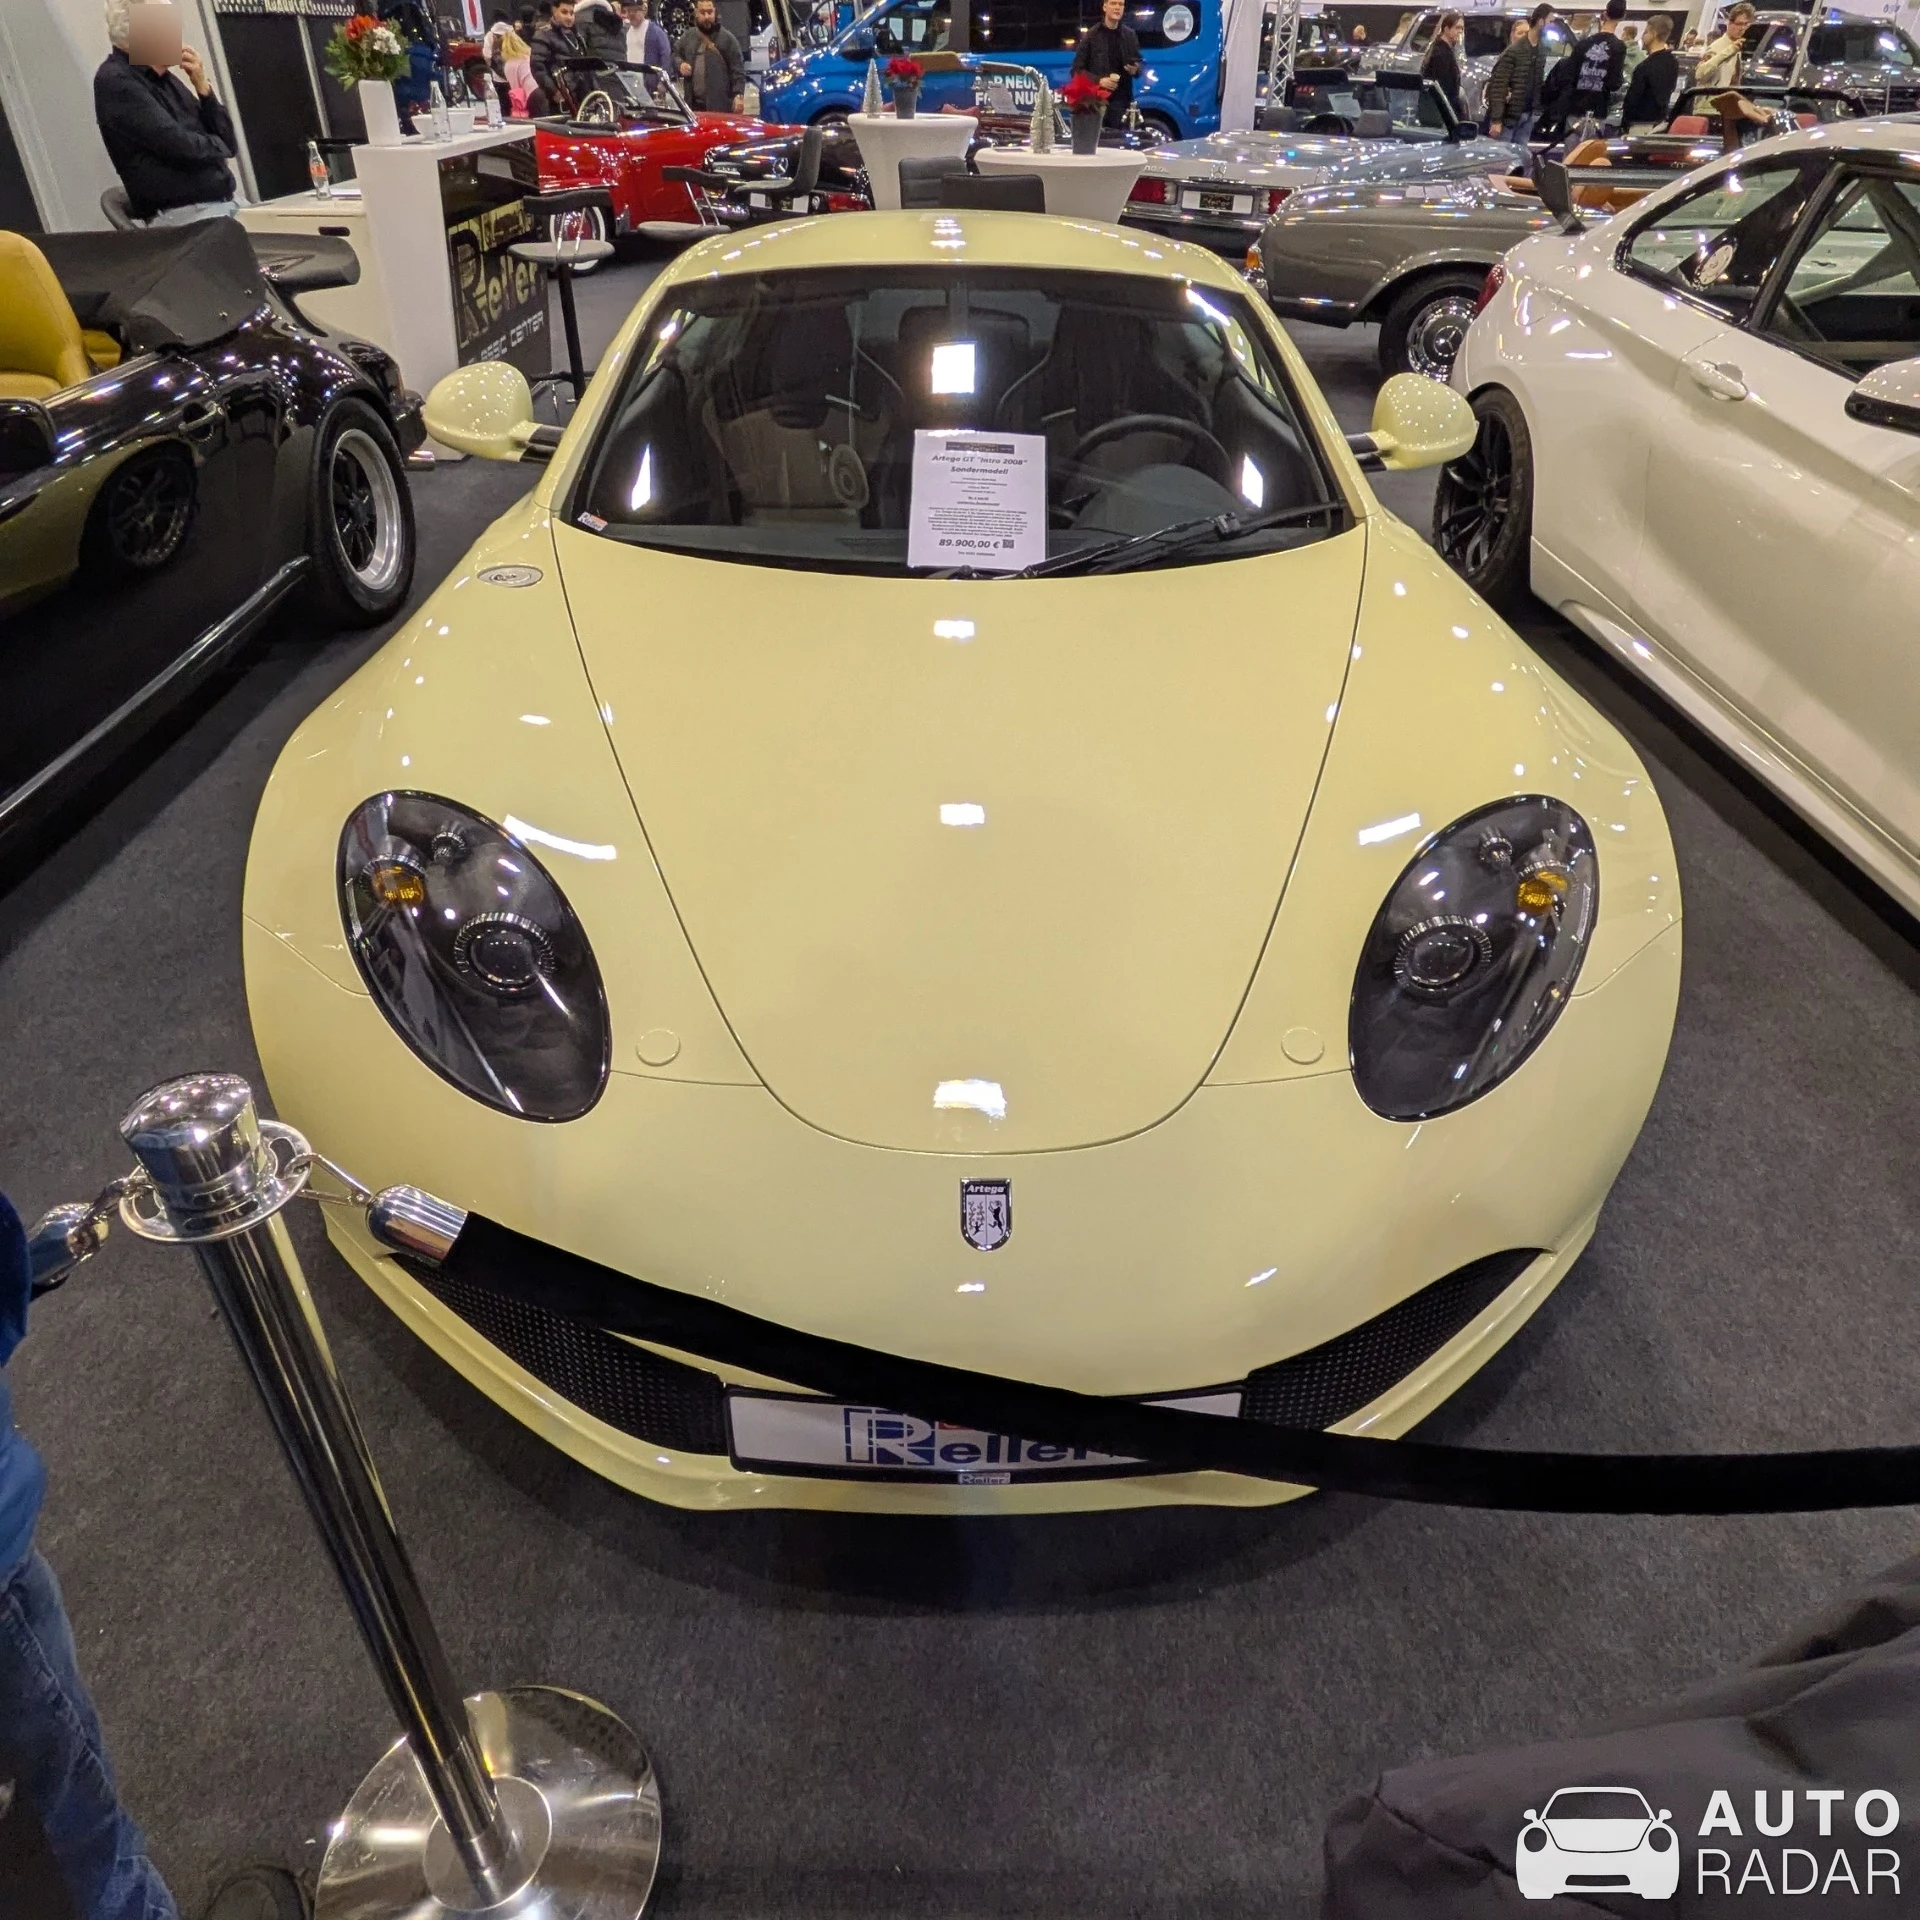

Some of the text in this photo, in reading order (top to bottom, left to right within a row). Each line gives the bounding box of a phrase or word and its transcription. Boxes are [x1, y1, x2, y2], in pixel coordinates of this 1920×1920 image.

[1015, 91, 1068, 105] NUE
[510, 310, 544, 347] CENTER
[931, 455, 961, 463] Artega
[950, 466, 1009, 475] Sondermodell
[938, 538, 1001, 549] 89.900,00 €
[967, 1184, 1006, 1194] Artega
